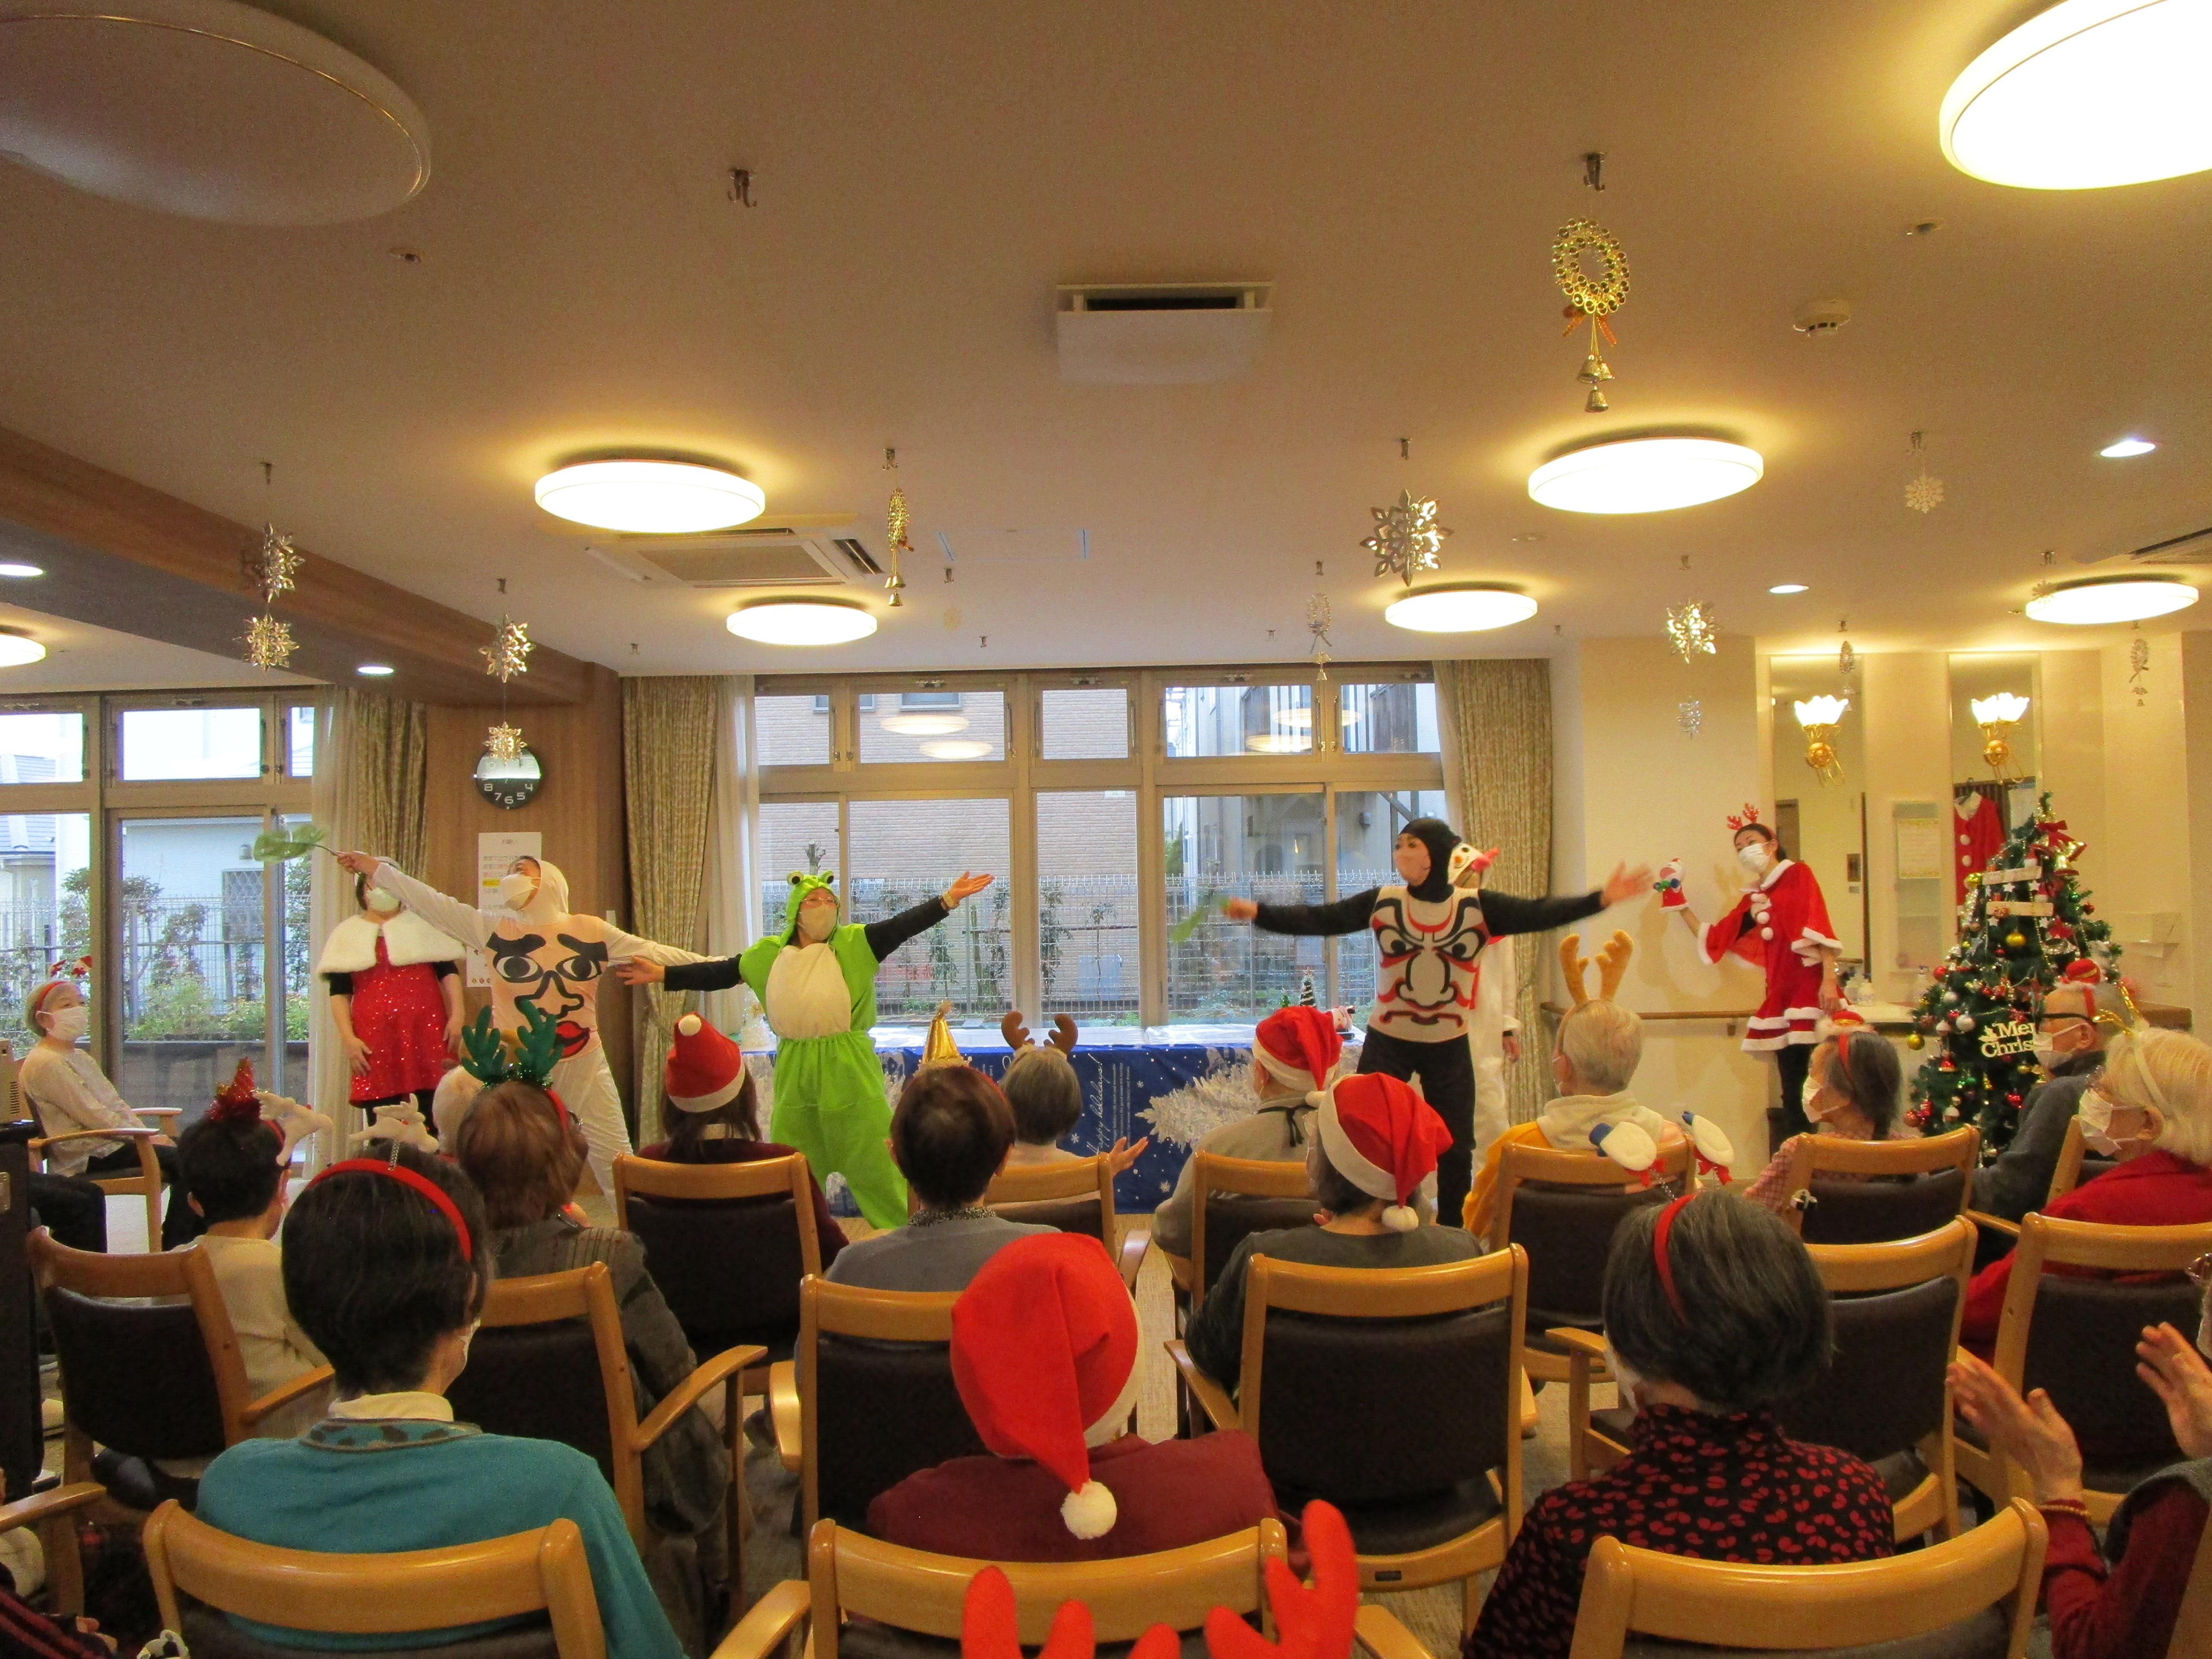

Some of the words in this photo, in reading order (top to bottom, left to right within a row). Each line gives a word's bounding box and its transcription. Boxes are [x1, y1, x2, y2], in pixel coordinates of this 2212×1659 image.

[484, 784, 493, 792] 8
[494, 793, 502, 801] 7
[504, 796, 514, 804] 6
[1981, 1040, 2034, 1058] Chris
